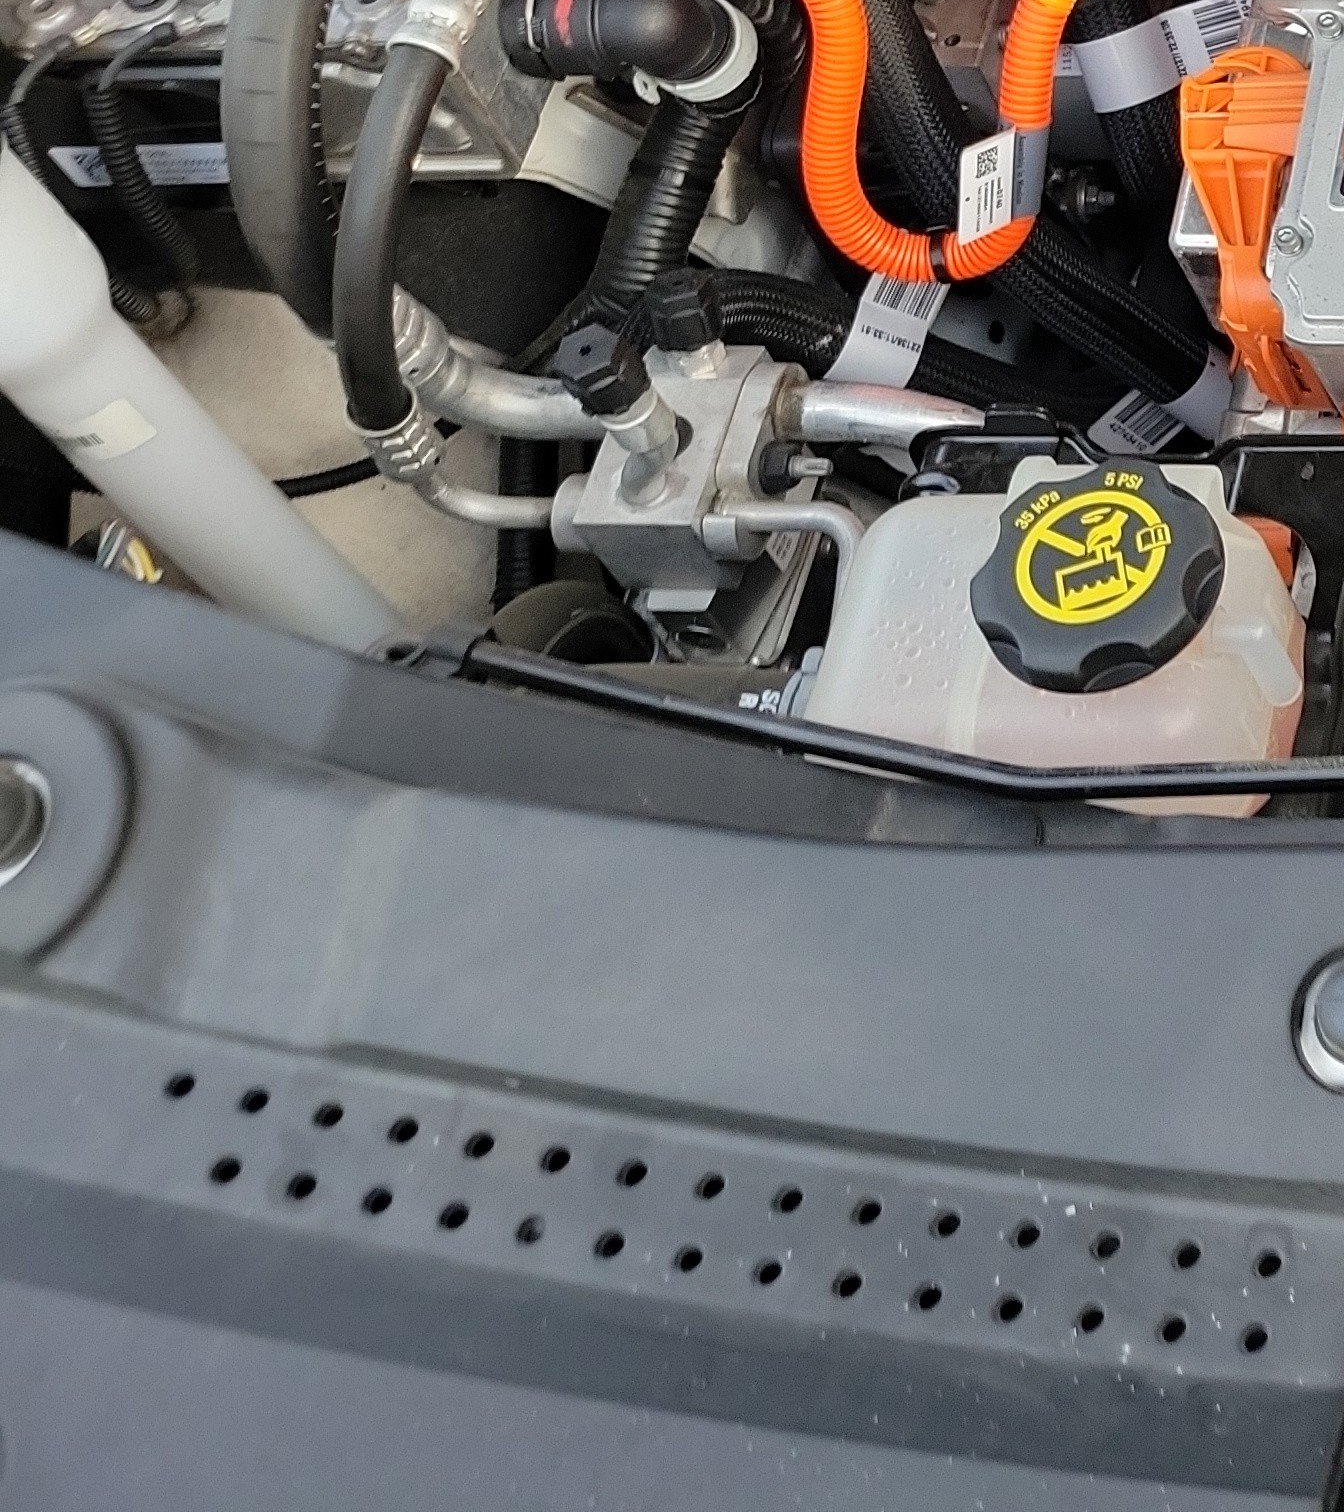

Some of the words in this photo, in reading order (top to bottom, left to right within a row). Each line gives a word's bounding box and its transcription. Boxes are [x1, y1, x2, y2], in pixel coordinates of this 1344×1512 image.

[1105, 472, 1116, 486] 5
[1118, 473, 1143, 490] PSI
[1015, 509, 1034, 530] 35
[1031, 490, 1061, 514] kPa
